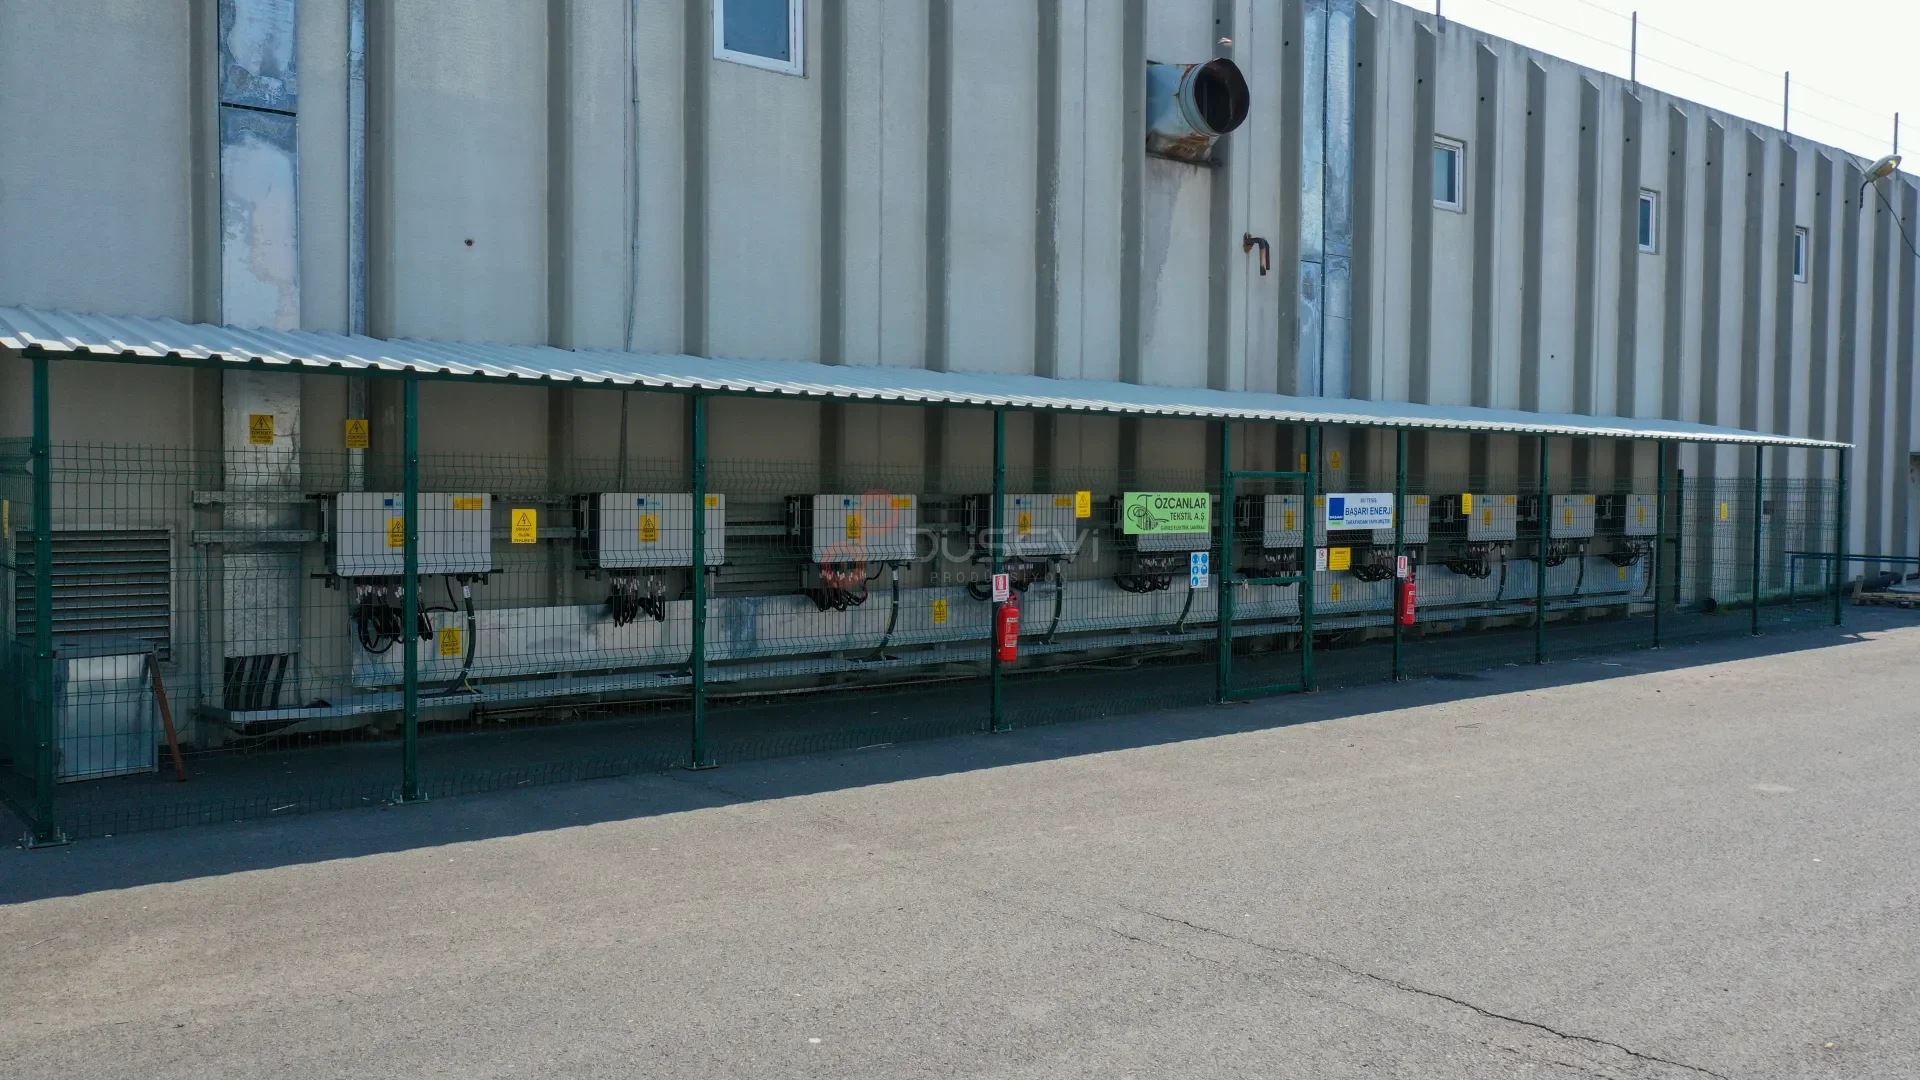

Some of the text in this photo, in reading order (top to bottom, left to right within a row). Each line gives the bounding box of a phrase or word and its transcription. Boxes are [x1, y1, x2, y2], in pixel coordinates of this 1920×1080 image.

[1155, 494, 1206, 509] ÖZCANLAR
[1170, 512, 1193, 521] TEKSTİL
[1345, 505, 1393, 518] BAŞARI ENERJİ
